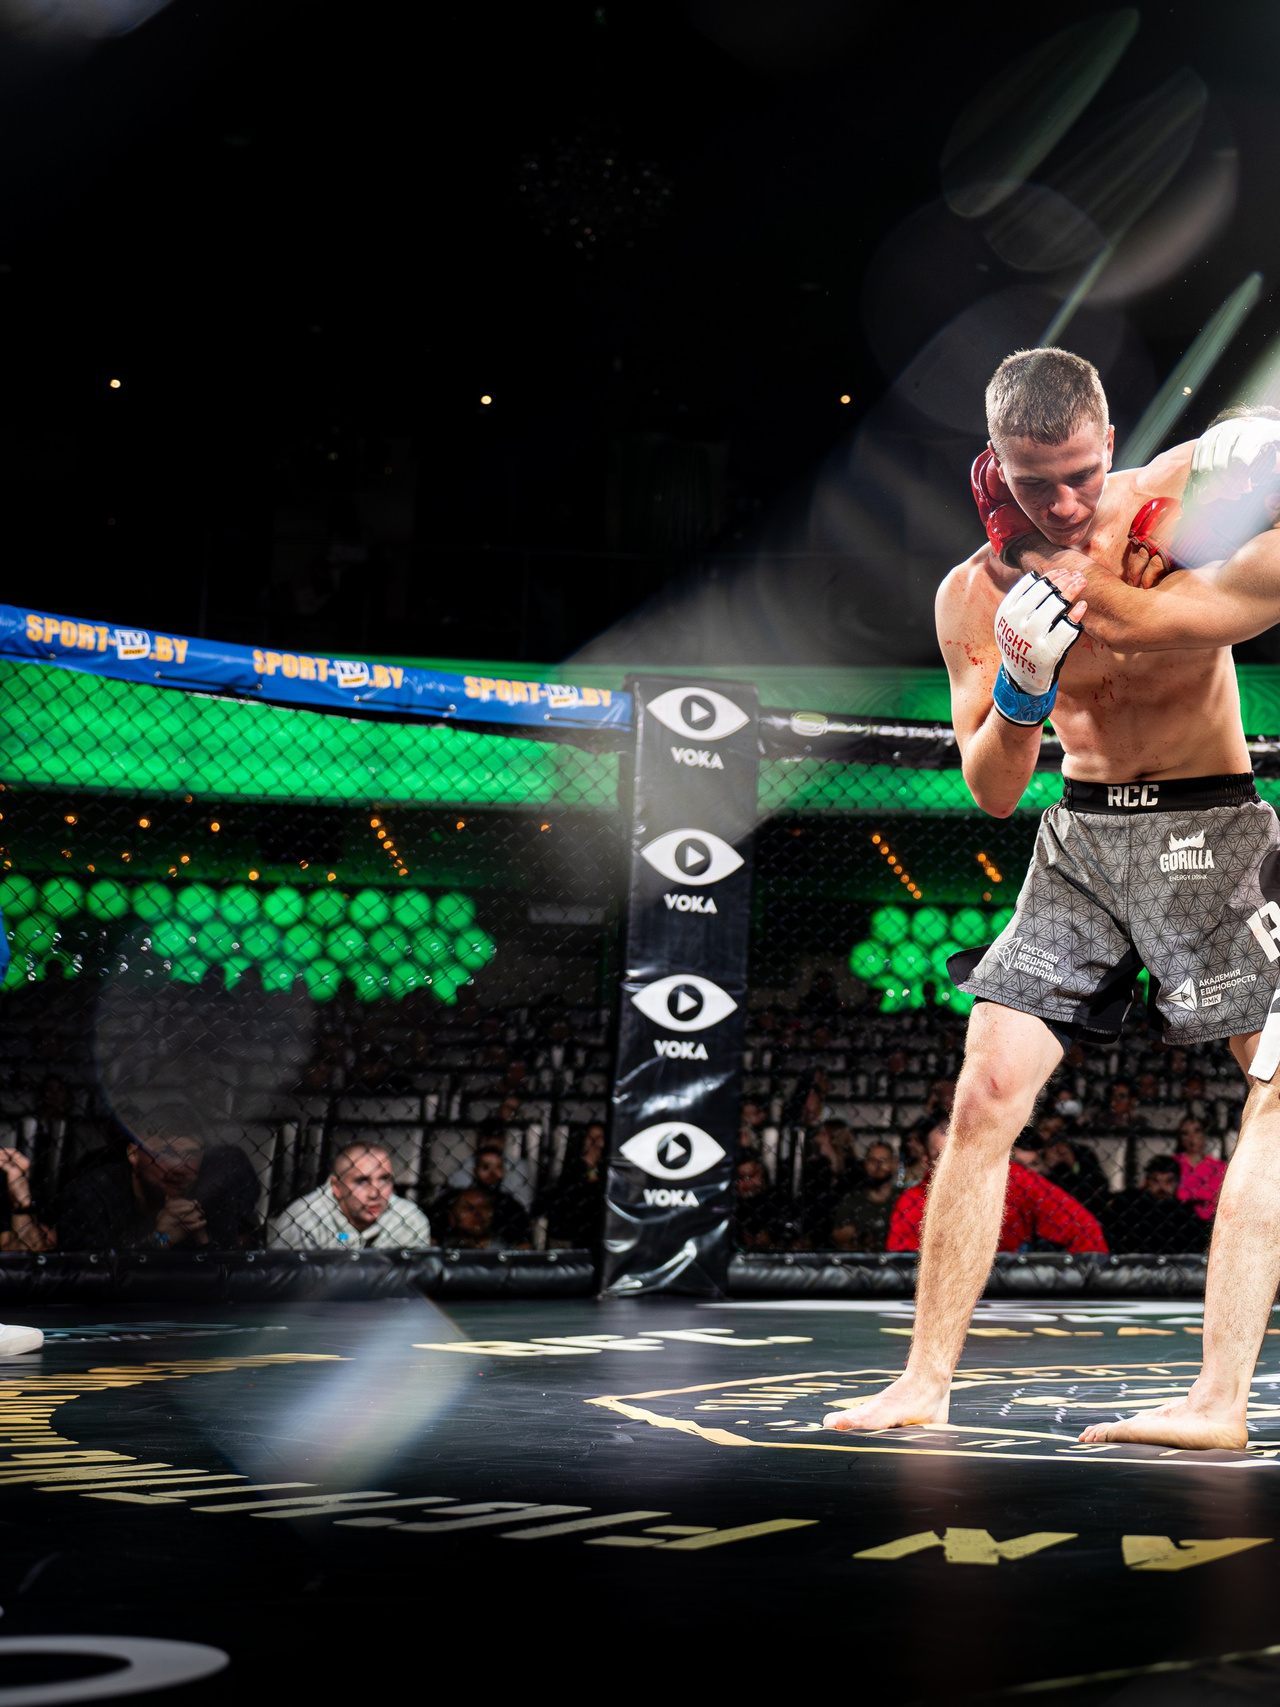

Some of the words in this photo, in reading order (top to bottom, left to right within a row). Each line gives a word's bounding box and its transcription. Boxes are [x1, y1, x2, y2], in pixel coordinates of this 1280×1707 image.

[997, 616, 1033, 656] FIGHT
[671, 746, 724, 770] VOKA
[1107, 784, 1160, 807] RCC
[1160, 850, 1215, 872] GORILLA
[664, 894, 718, 914] VOKA
[1017, 952, 1054, 971] МЕДНАЯ
[1020, 943, 1059, 964] РУССКАЯ
[1013, 960, 1063, 985] КОМПАНИЯ
[1199, 969, 1241, 987] АКАДЕМИЯ
[1200, 974, 1257, 996] ЕДИНОБОРСТВ
[654, 1040, 708, 1061] VOKA
[643, 1189, 699, 1208] VOKA
